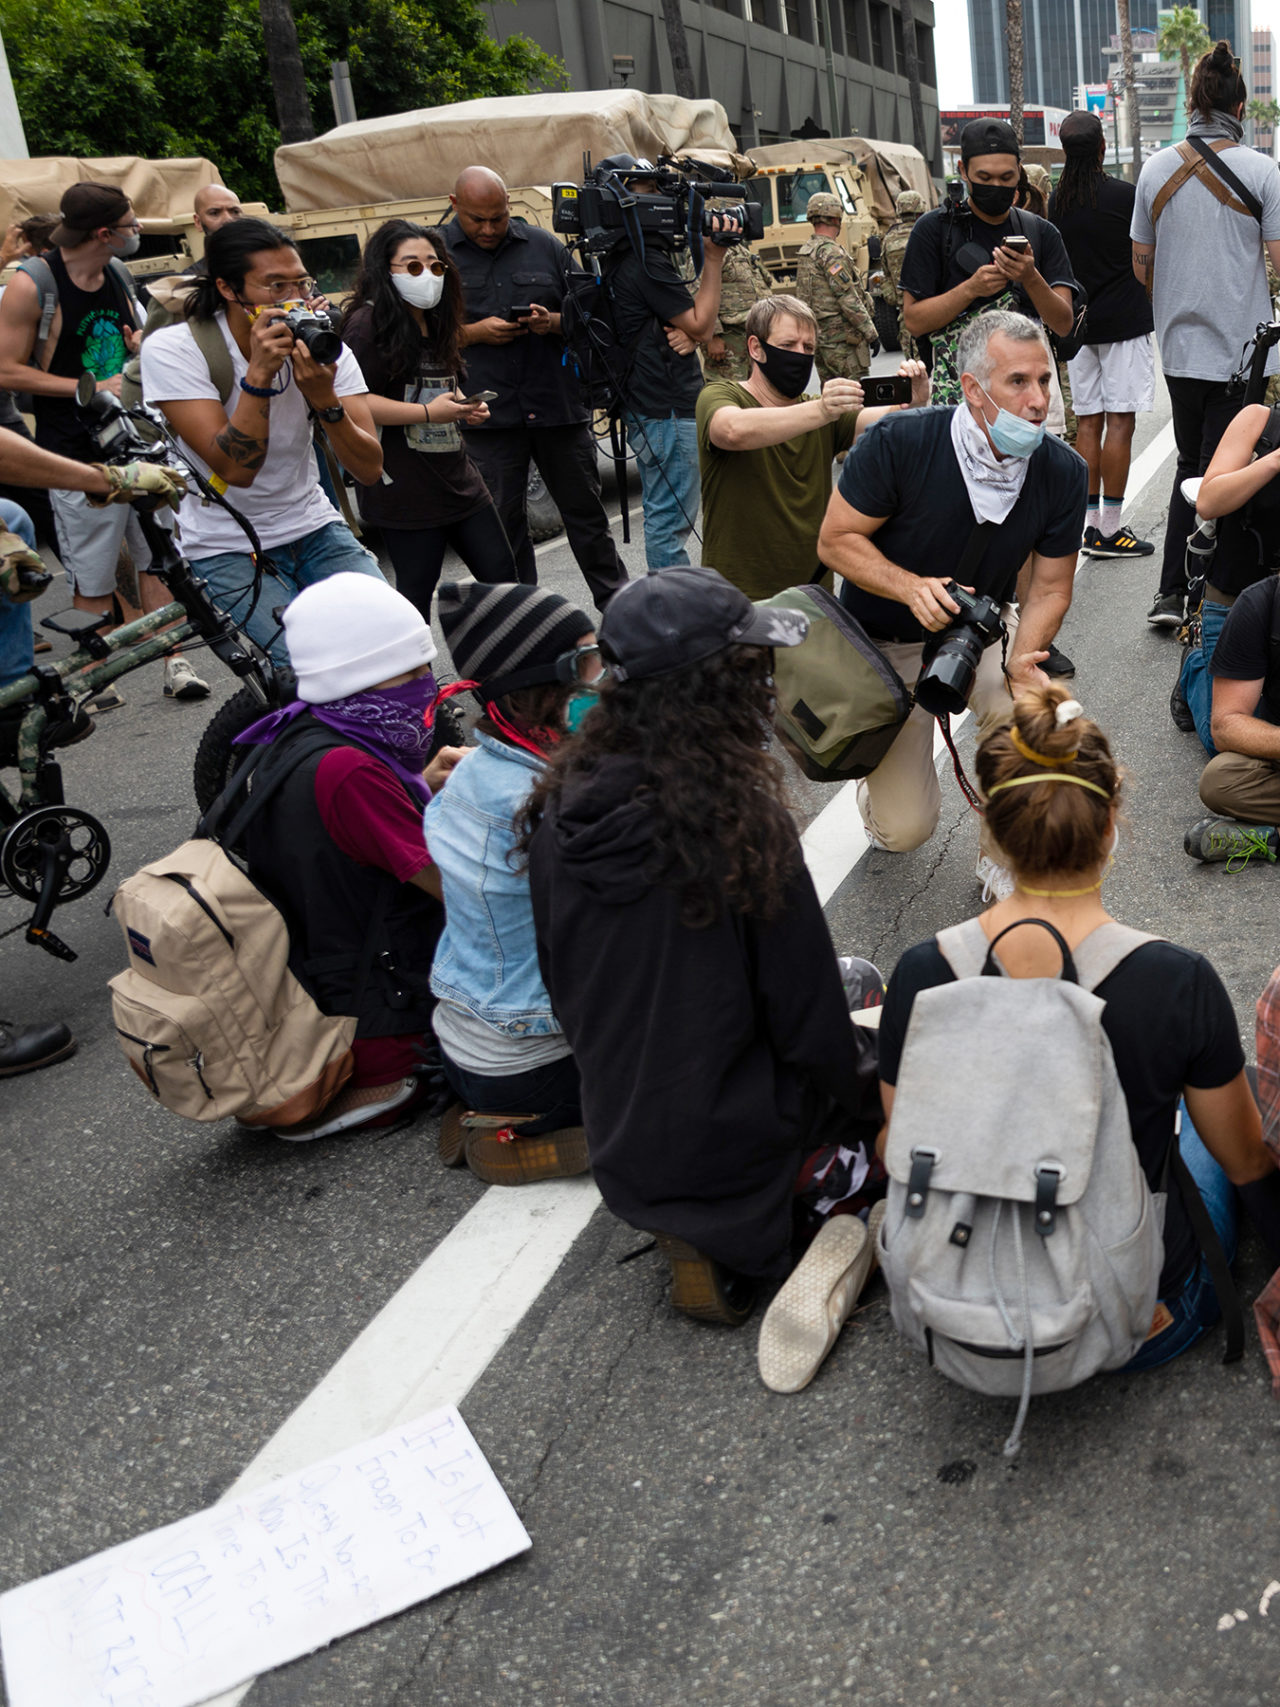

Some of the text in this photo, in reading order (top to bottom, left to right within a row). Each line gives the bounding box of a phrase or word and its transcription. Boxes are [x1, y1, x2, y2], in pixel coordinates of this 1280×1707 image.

[355, 1450, 402, 1517] Enough
[394, 1511, 428, 1544] To
[400, 1415, 496, 1540] It Is Not
[210, 1504, 244, 1560] Time
[235, 1557, 266, 1589] To
[273, 1532, 310, 1572] Is
